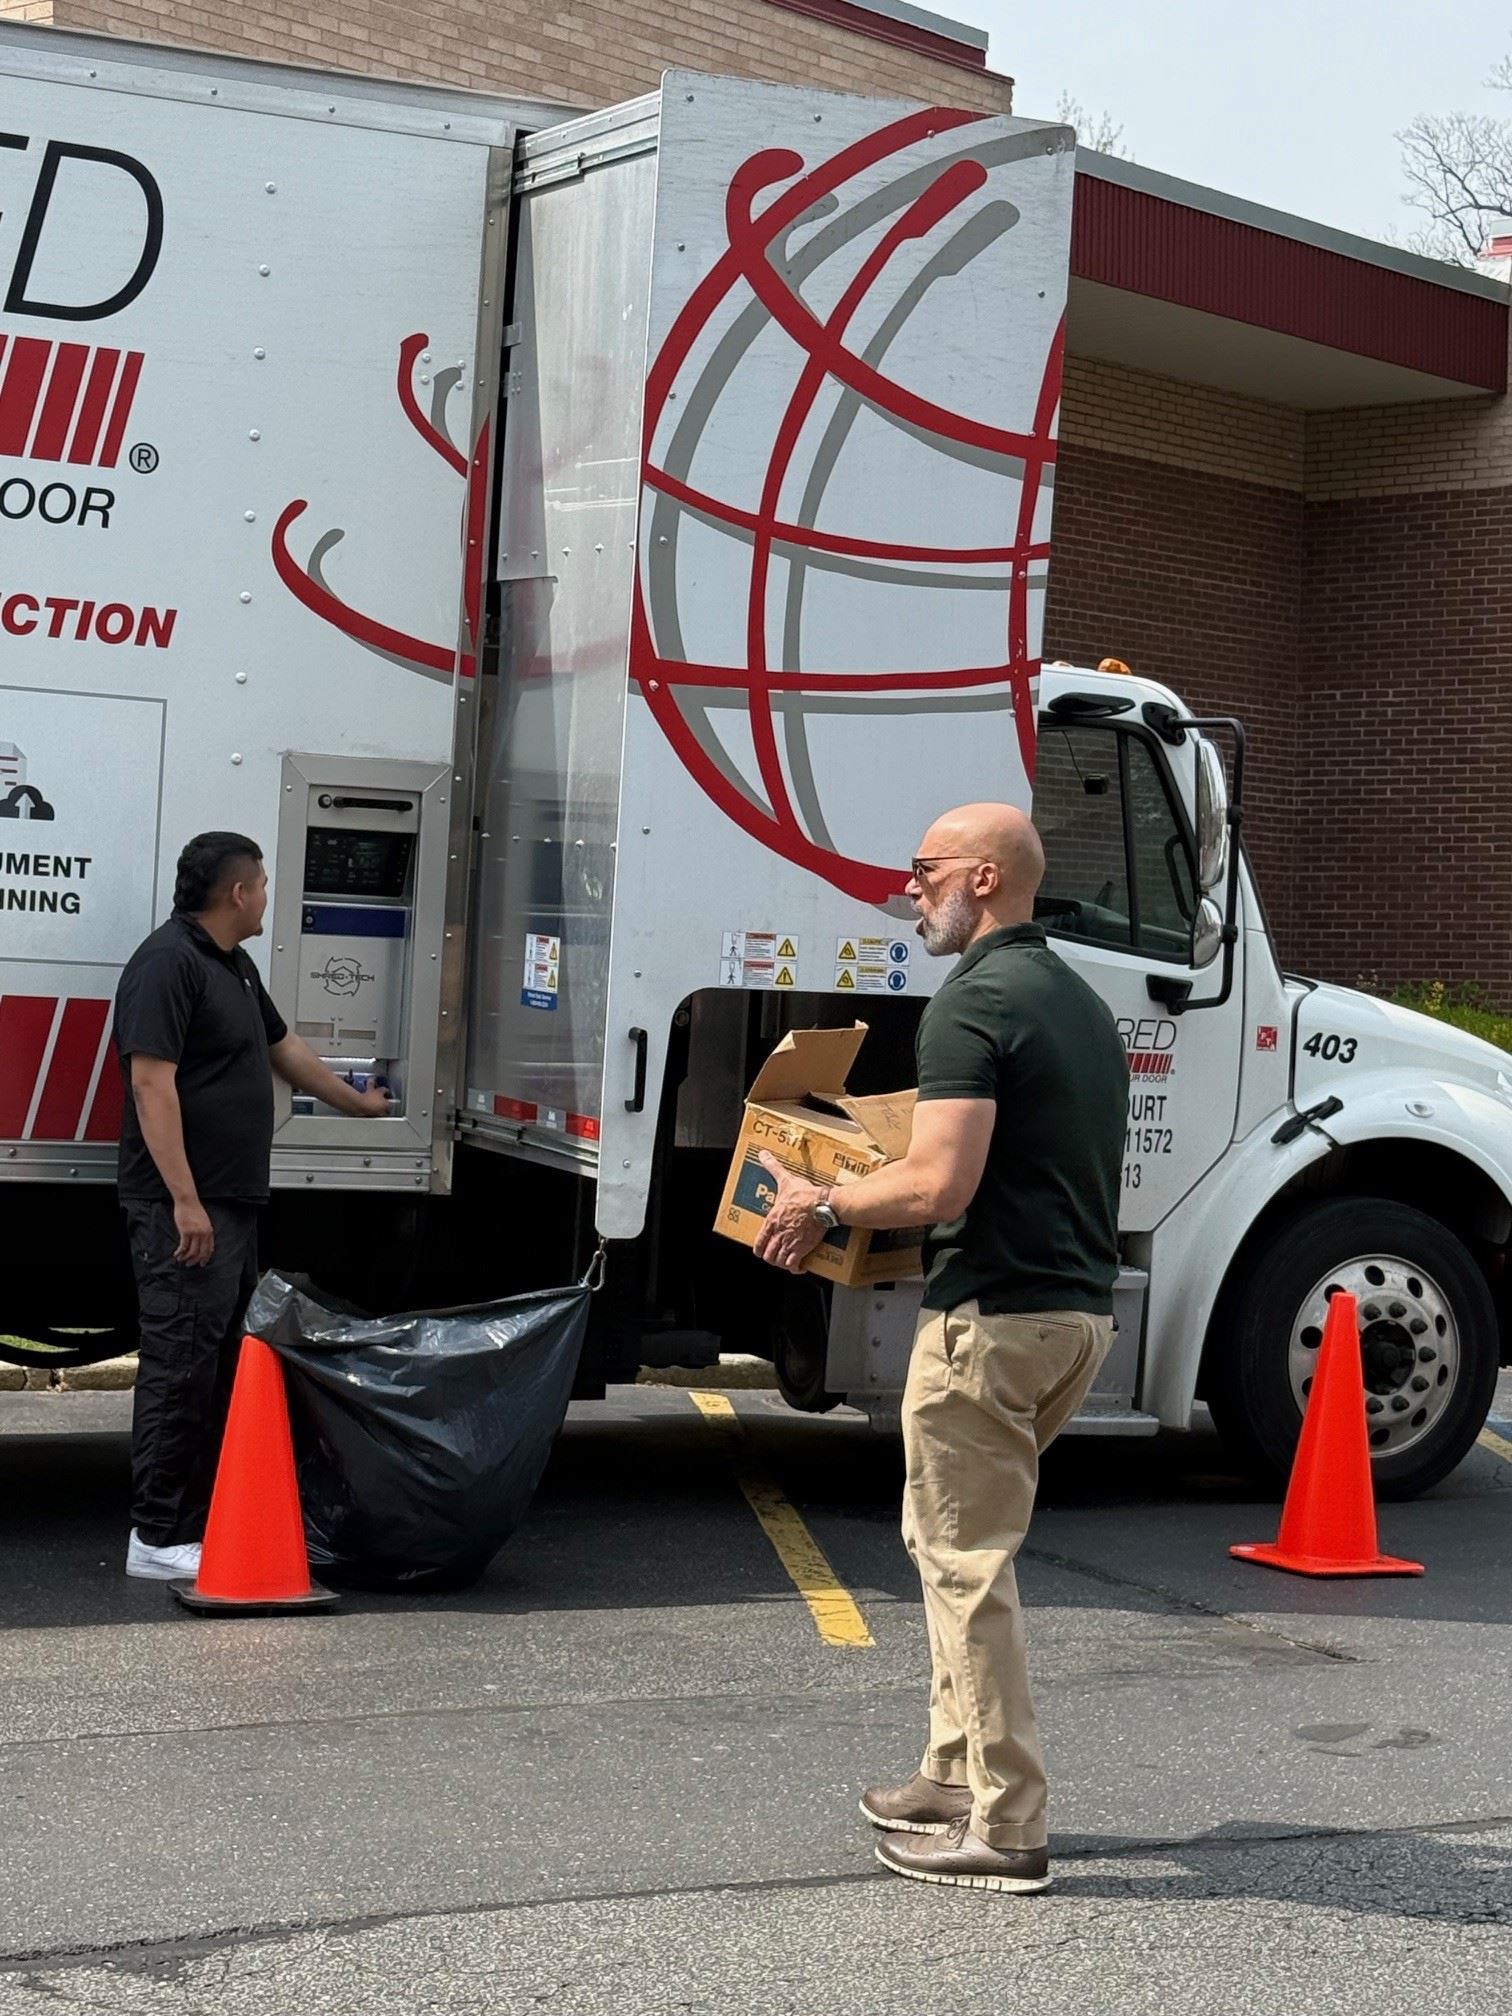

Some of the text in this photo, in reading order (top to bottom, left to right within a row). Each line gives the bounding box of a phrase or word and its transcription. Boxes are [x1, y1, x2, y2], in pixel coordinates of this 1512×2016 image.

[0, 478, 115, 529] OOR
[0, 593, 178, 649] CTION
[0, 852, 92, 879] MENT
[1303, 1032, 1358, 1063] 403
[1142, 1075, 1168, 1084] DOOR
[1127, 1094, 1168, 1121] URT
[1126, 1127, 1173, 1154] 11572
[1120, 1162, 1142, 1189] 13
